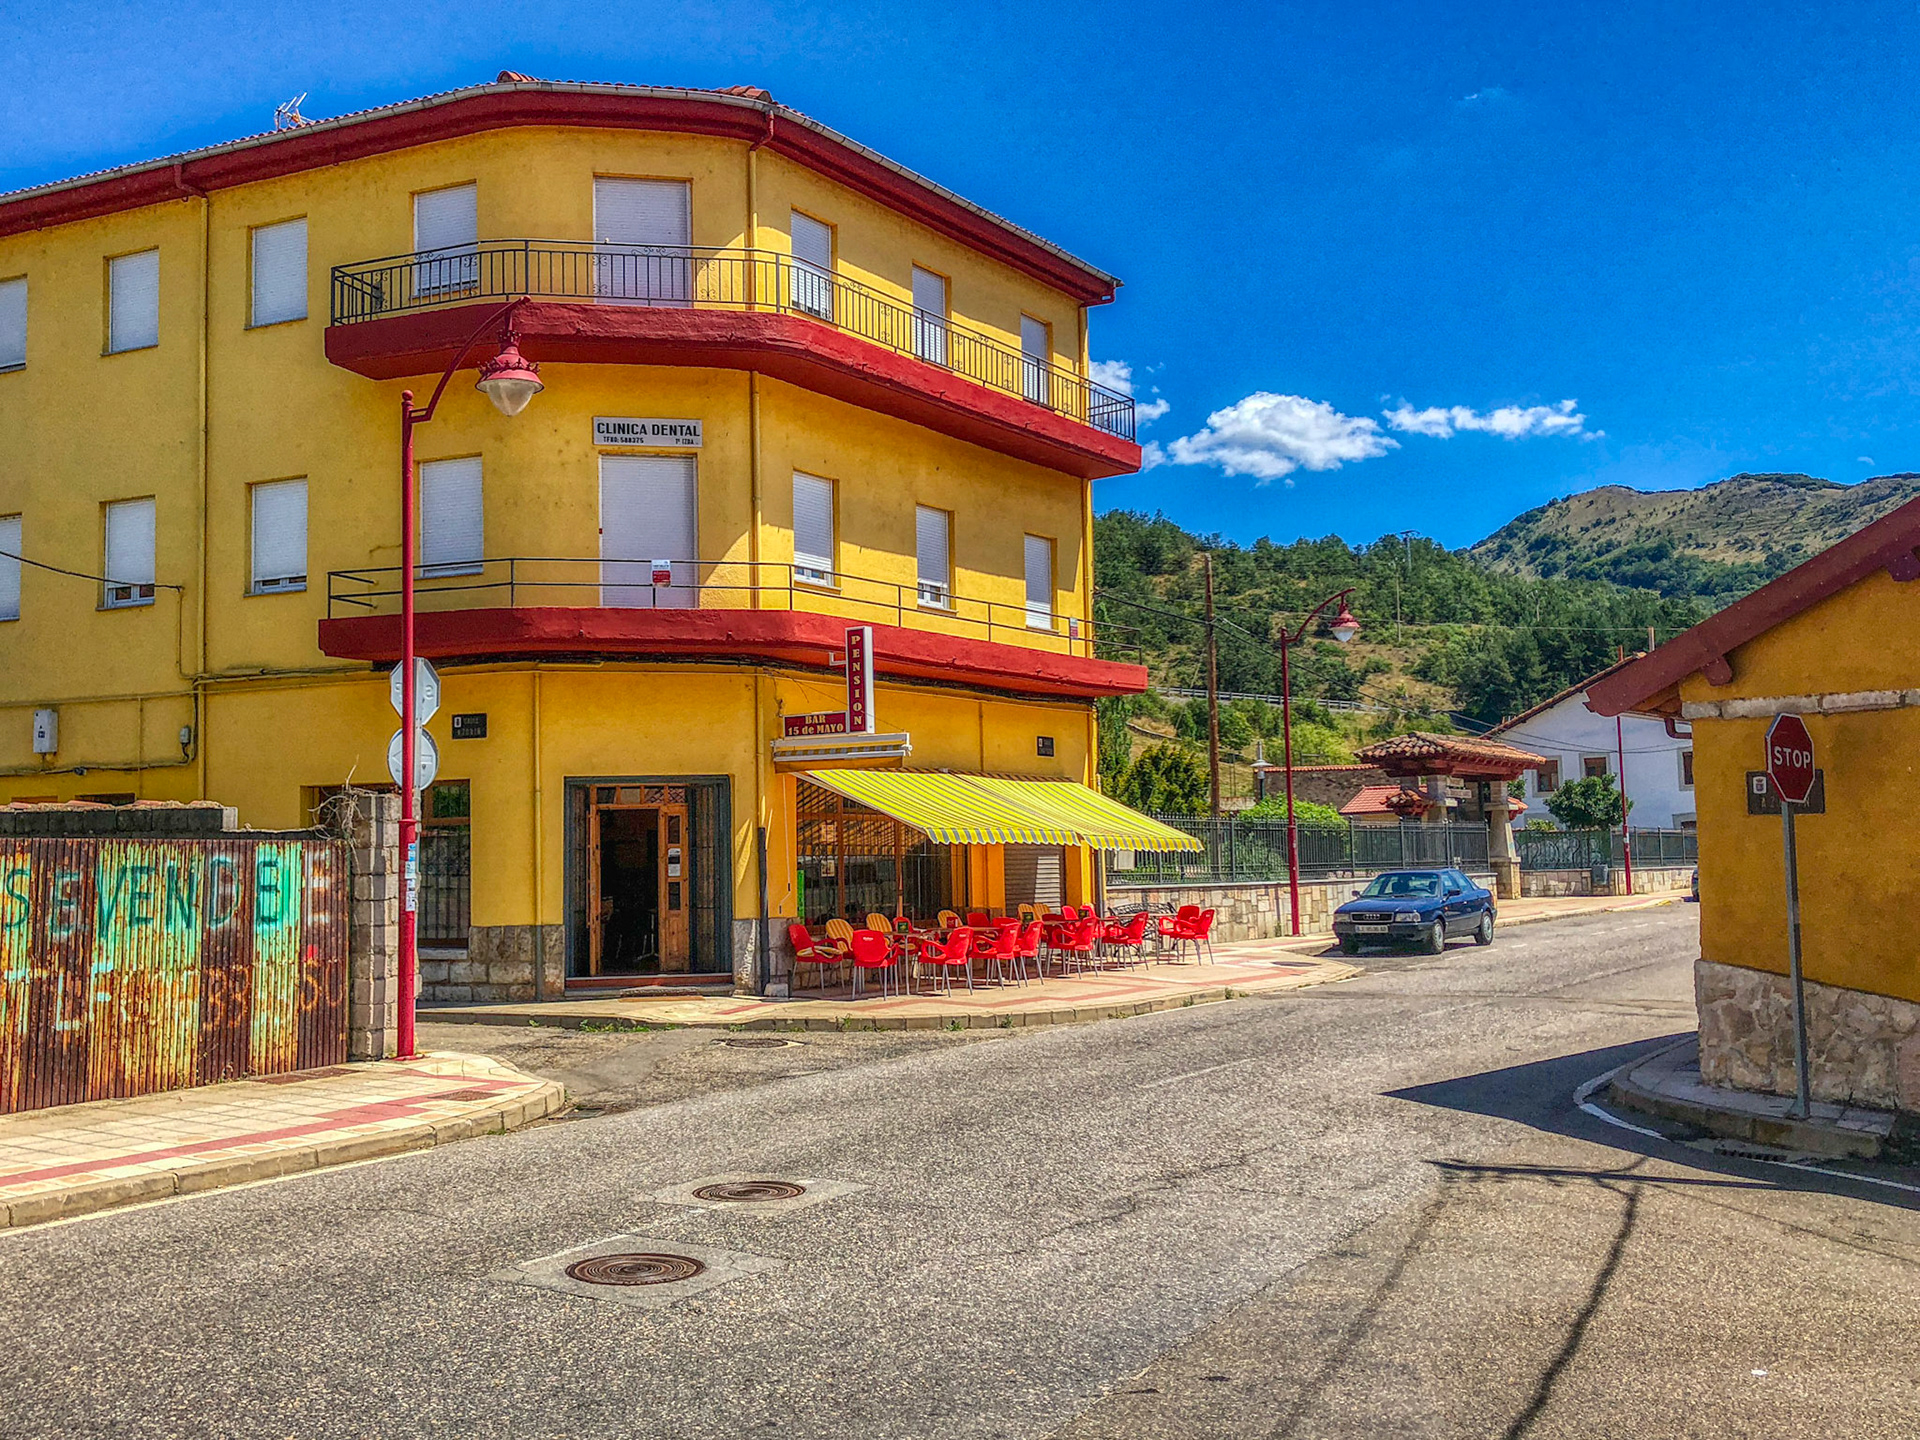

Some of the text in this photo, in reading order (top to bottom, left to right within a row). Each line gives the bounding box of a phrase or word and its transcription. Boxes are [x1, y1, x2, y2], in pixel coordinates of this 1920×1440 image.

[597, 422, 700, 437] CLINICA DENTAL
[851, 635, 863, 725] PENSION
[805, 715, 826, 724] BAR
[788, 723, 844, 736] 15 de MAYO
[1774, 746, 1811, 769] STOP
